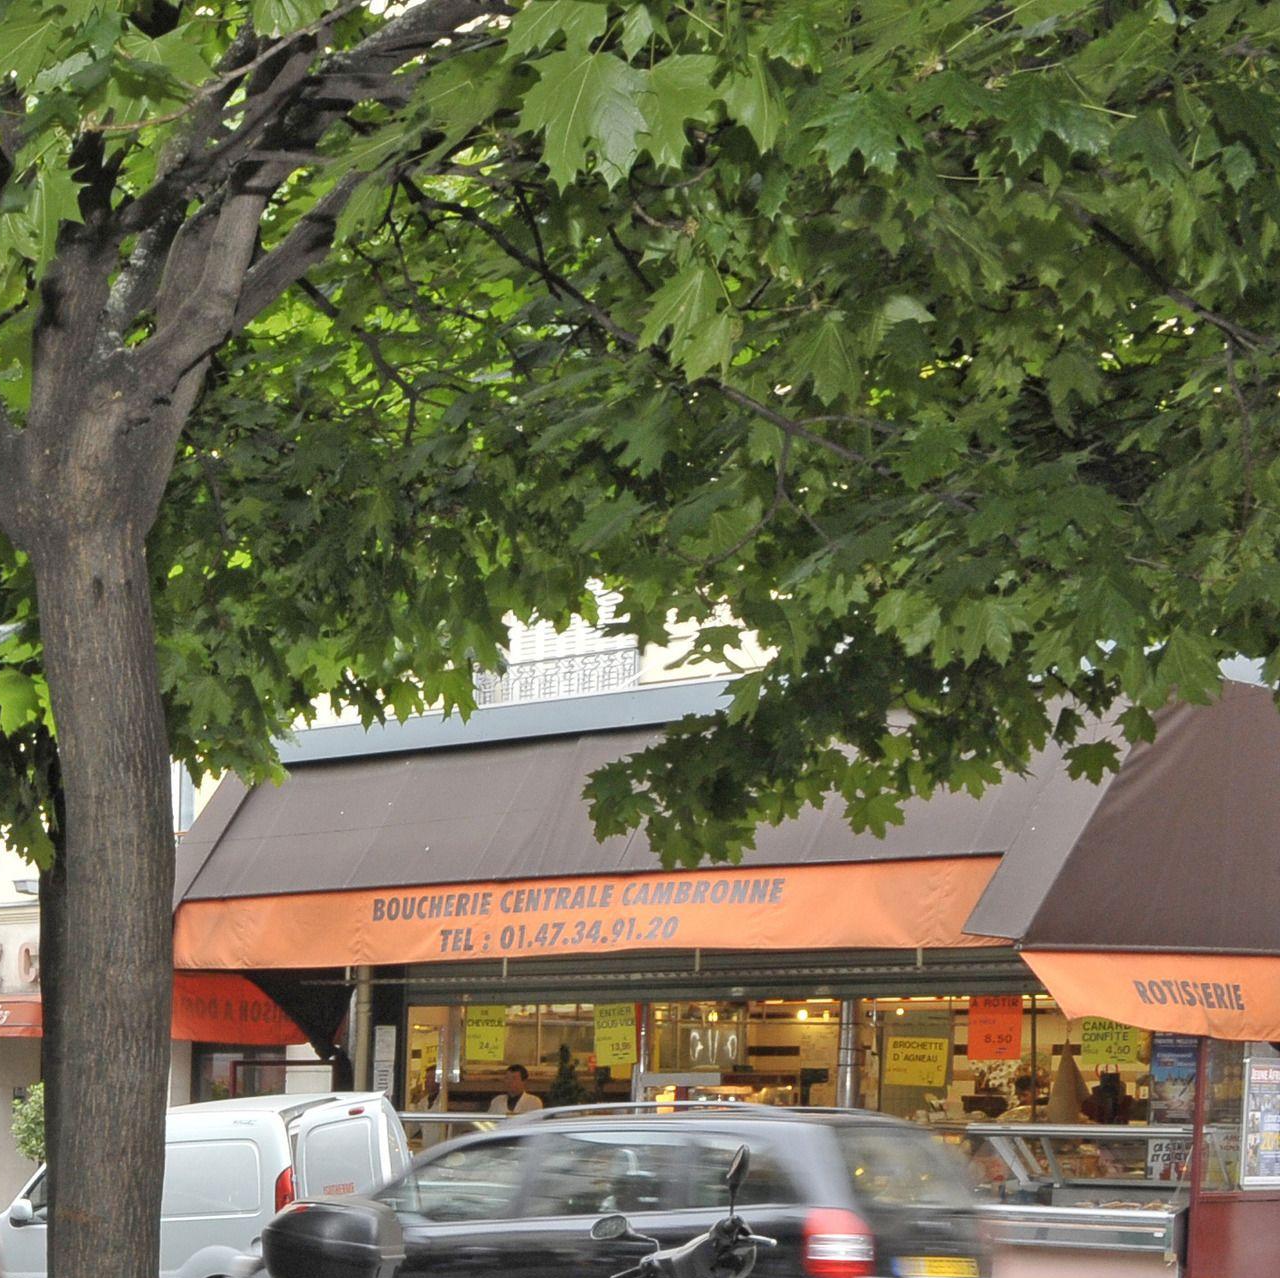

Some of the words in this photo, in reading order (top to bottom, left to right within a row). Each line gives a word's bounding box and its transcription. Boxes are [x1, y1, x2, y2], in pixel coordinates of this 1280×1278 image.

[372, 892, 493, 922] BOUCHERIE
[499, 884, 615, 914] CENTRALE
[621, 877, 785, 907] CAMBRONNE
[440, 928, 474, 953] TEL
[499, 915, 681, 950] 01.47.34.91.20
[1134, 979, 1245, 1011] ROTISSERIE
[893, 1040, 944, 1050] BROCHETTE
[1082, 1031, 1129, 1042] CONFITE
